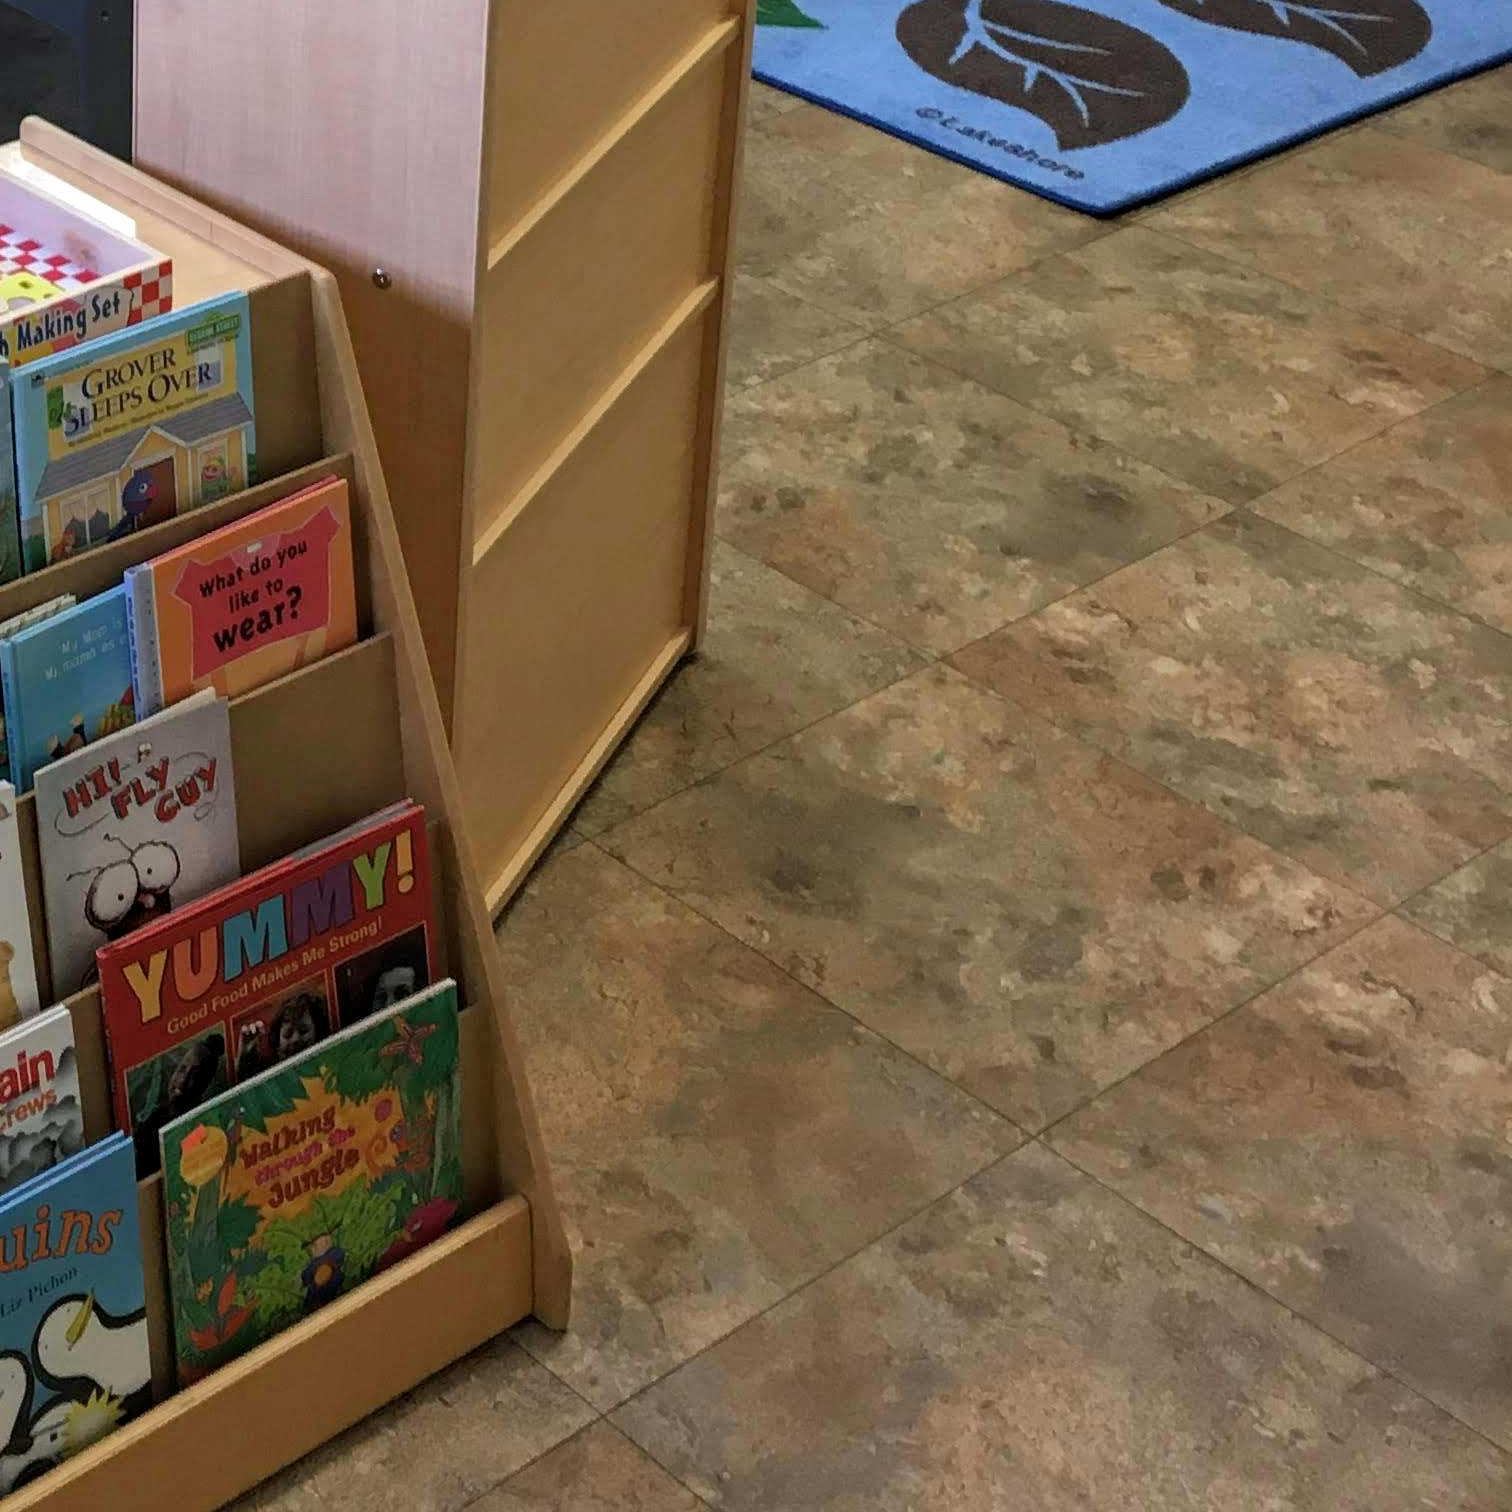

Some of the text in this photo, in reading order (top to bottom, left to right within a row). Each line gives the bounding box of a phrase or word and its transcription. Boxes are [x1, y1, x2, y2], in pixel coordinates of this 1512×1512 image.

[17, 305, 88, 352] Making
[90, 290, 121, 323] Set
[198, 540, 308, 599] What do you
[227, 576, 284, 615] like to
[212, 585, 303, 654] wear?
[62, 755, 217, 823] HI! FLY GUY
[121, 828, 415, 1024] YUMMY!
[166, 914, 384, 1036] Good Food Makes Me Strong!
[240, 1104, 337, 1169] Walking
[254, 1139, 324, 1186] through
[266, 1146, 361, 1209] Jungle
[0, 1266, 79, 1319] Liz Pichon
